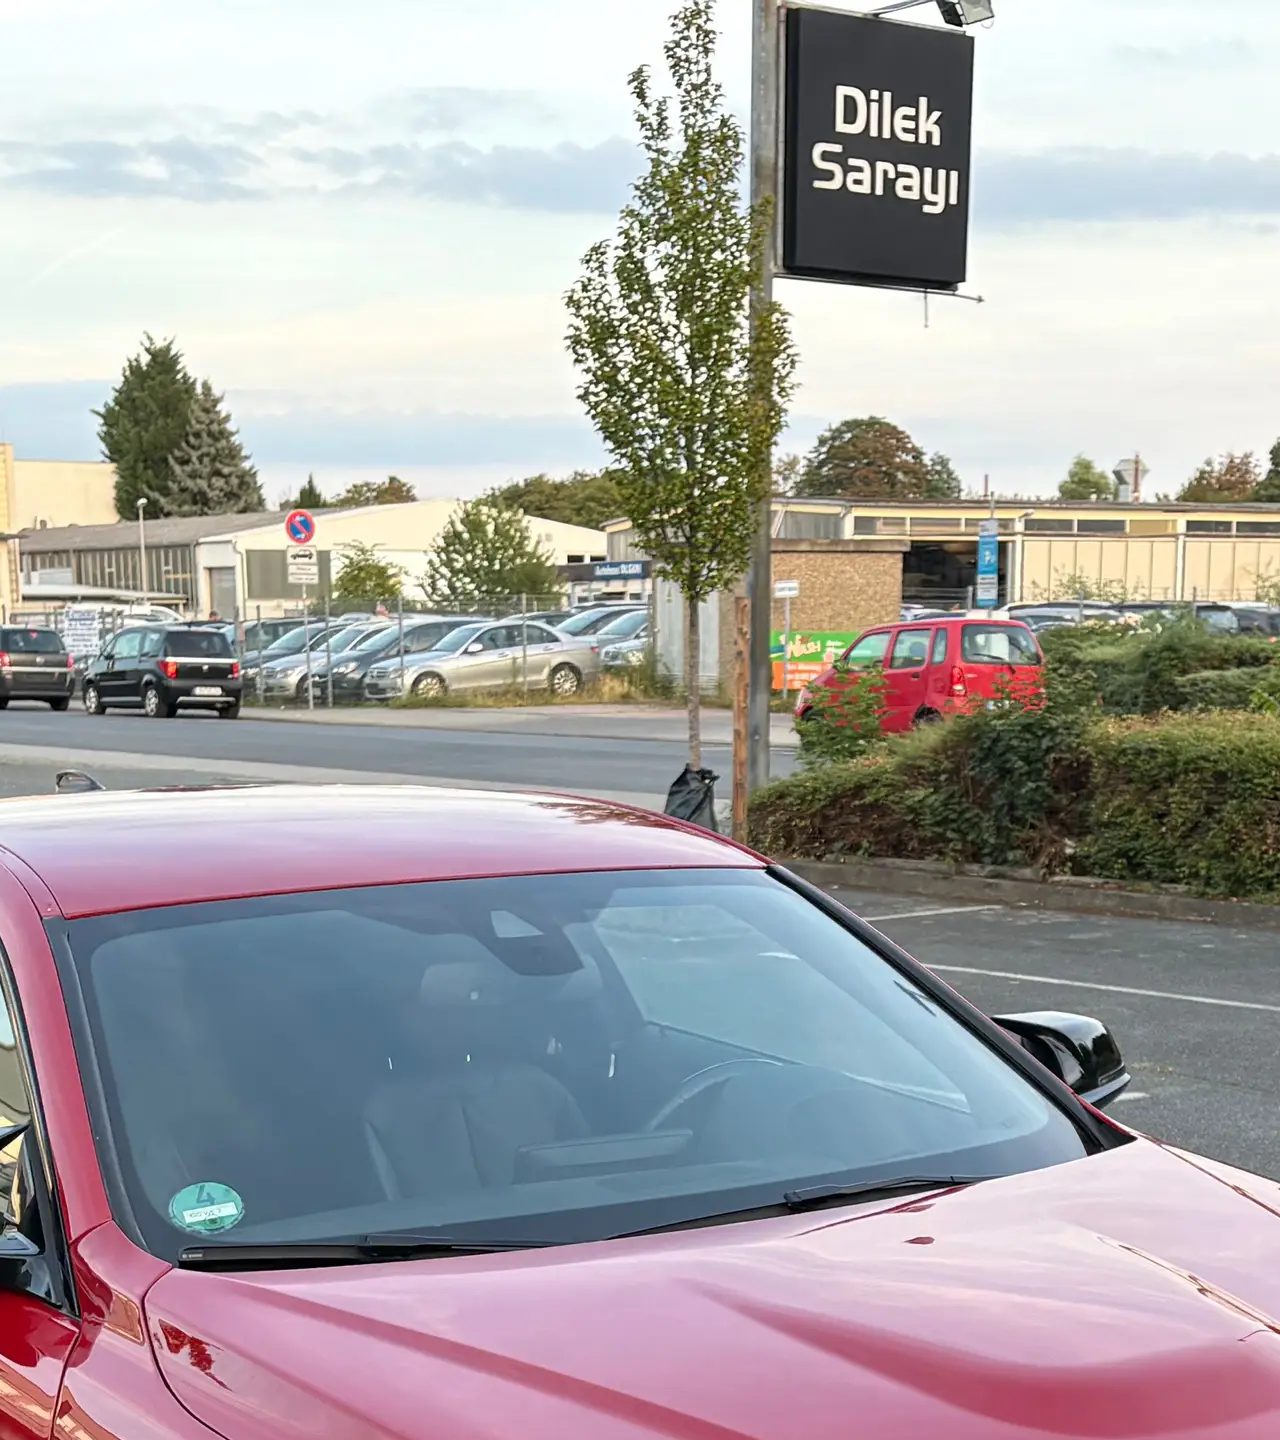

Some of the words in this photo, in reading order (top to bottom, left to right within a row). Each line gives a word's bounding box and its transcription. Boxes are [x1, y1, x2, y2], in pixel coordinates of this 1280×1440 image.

[834, 84, 943, 146] Dilek
[811, 141, 959, 214] Sarayı
[196, 1184, 216, 1205] 4
